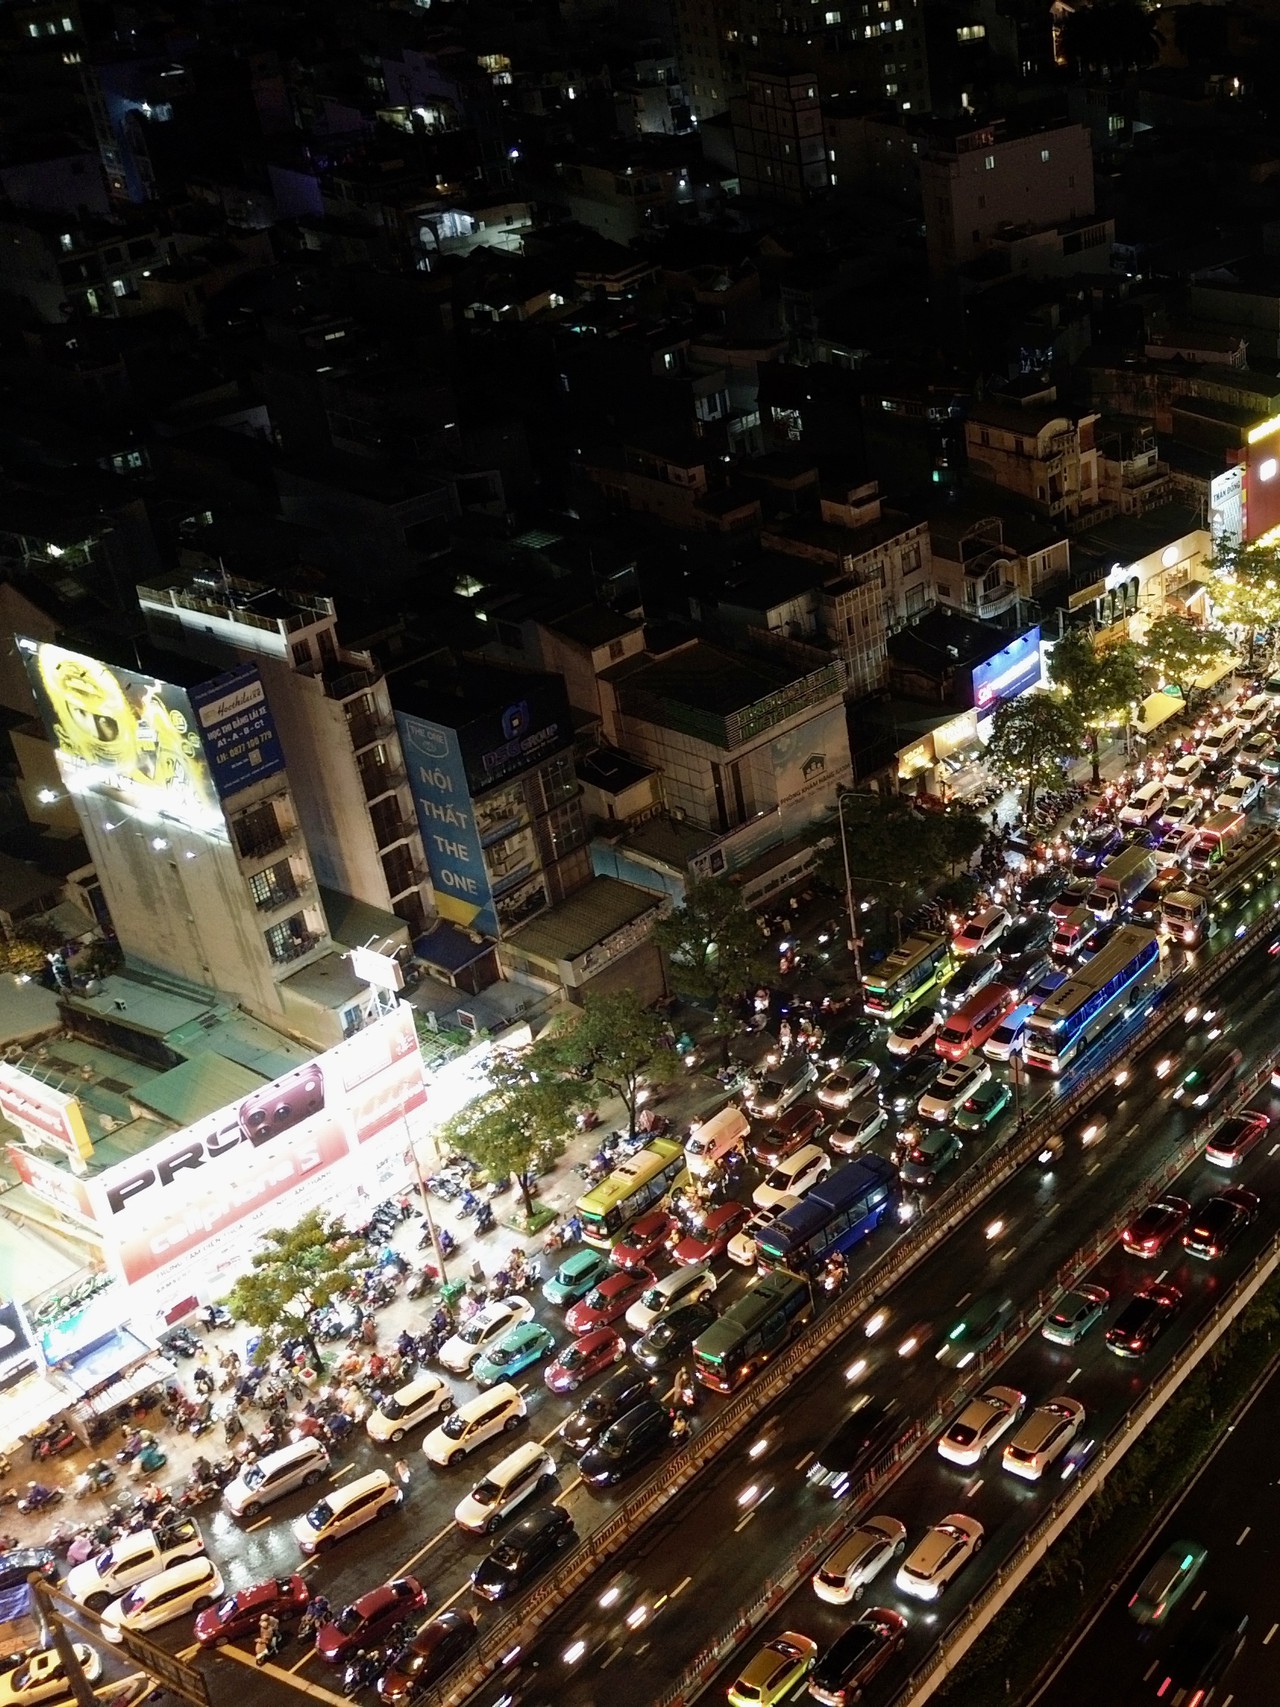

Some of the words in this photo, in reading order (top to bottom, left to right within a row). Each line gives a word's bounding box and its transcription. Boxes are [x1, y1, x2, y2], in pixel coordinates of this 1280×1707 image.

[420, 767, 454, 794] NỘI
[420, 798, 468, 830] THẤT
[433, 834, 470, 862] THE
[440, 868, 479, 896] ONE
